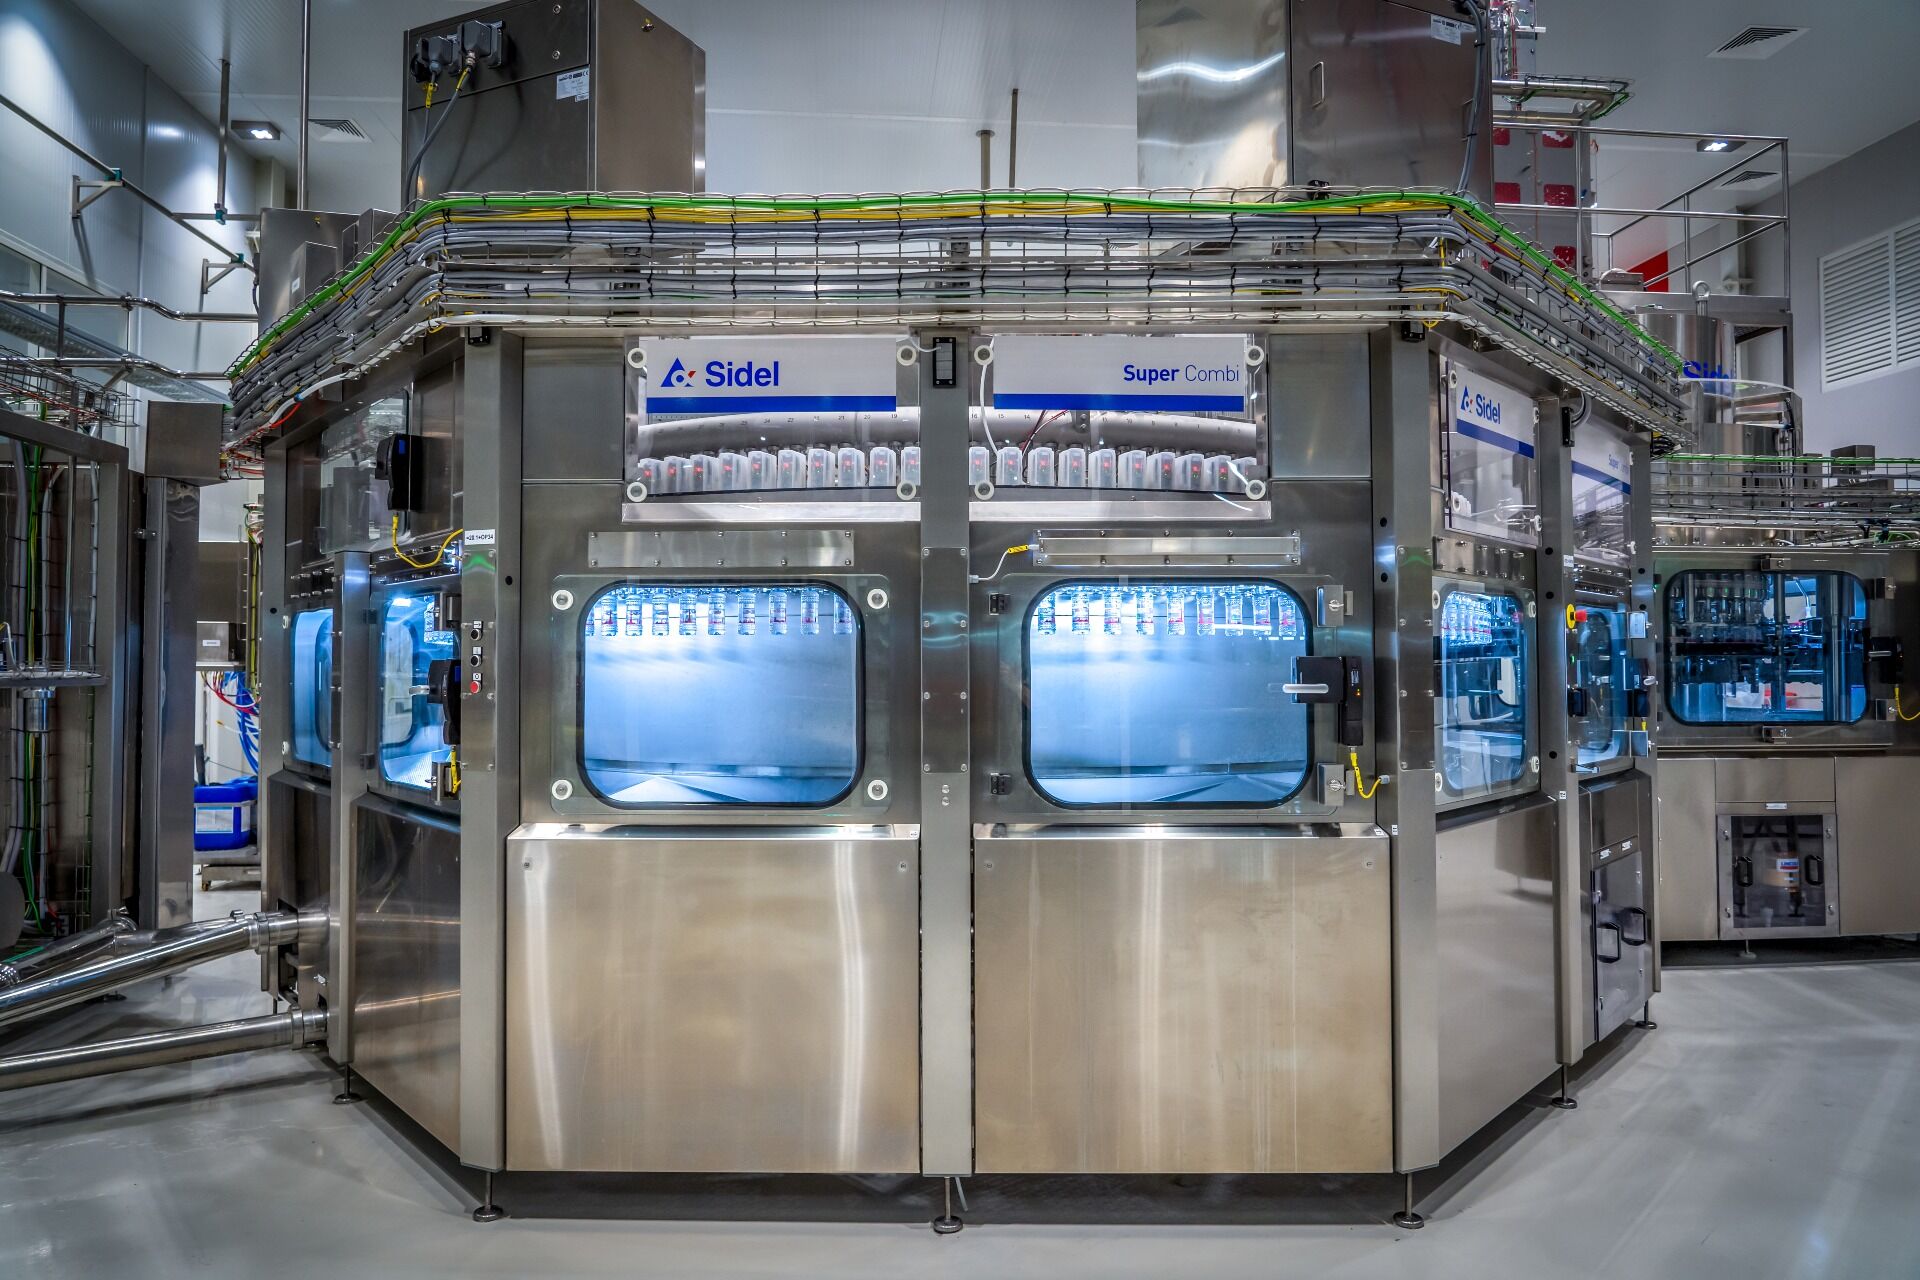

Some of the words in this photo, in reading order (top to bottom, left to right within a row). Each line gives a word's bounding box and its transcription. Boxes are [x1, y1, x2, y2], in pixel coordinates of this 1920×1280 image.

[705, 360, 779, 387] Sidel
[1123, 364, 1180, 386] Super
[1185, 364, 1239, 382] Combi
[1475, 393, 1501, 425] Sidel
